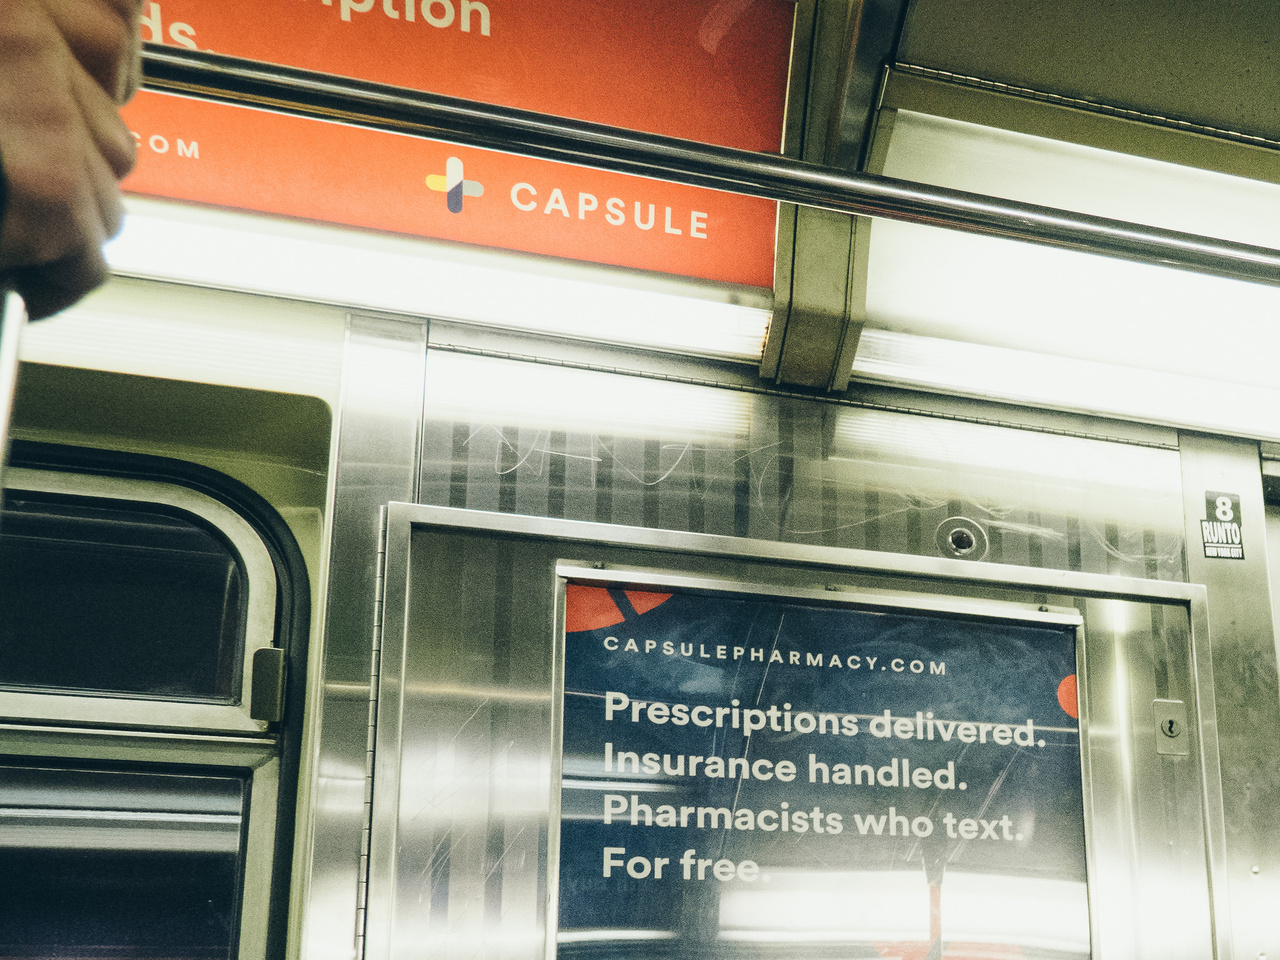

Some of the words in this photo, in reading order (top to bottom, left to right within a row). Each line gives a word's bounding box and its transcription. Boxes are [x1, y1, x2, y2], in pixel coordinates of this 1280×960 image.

[510, 182, 708, 239] CAPSULE
[1215, 496, 1234, 521] 8
[603, 636, 946, 675] CAPSULEPHARMACY.COM
[605, 691, 859, 737] Prescriptions
[869, 709, 1046, 748] delivered.
[604, 742, 797, 782] Insurance
[808, 753, 967, 790] handled.
[604, 794, 843, 835] Pharmacists
[854, 807, 934, 838] who
[943, 812, 1024, 841] text.
[603, 847, 669, 879] For
[680, 849, 771, 882] free.
